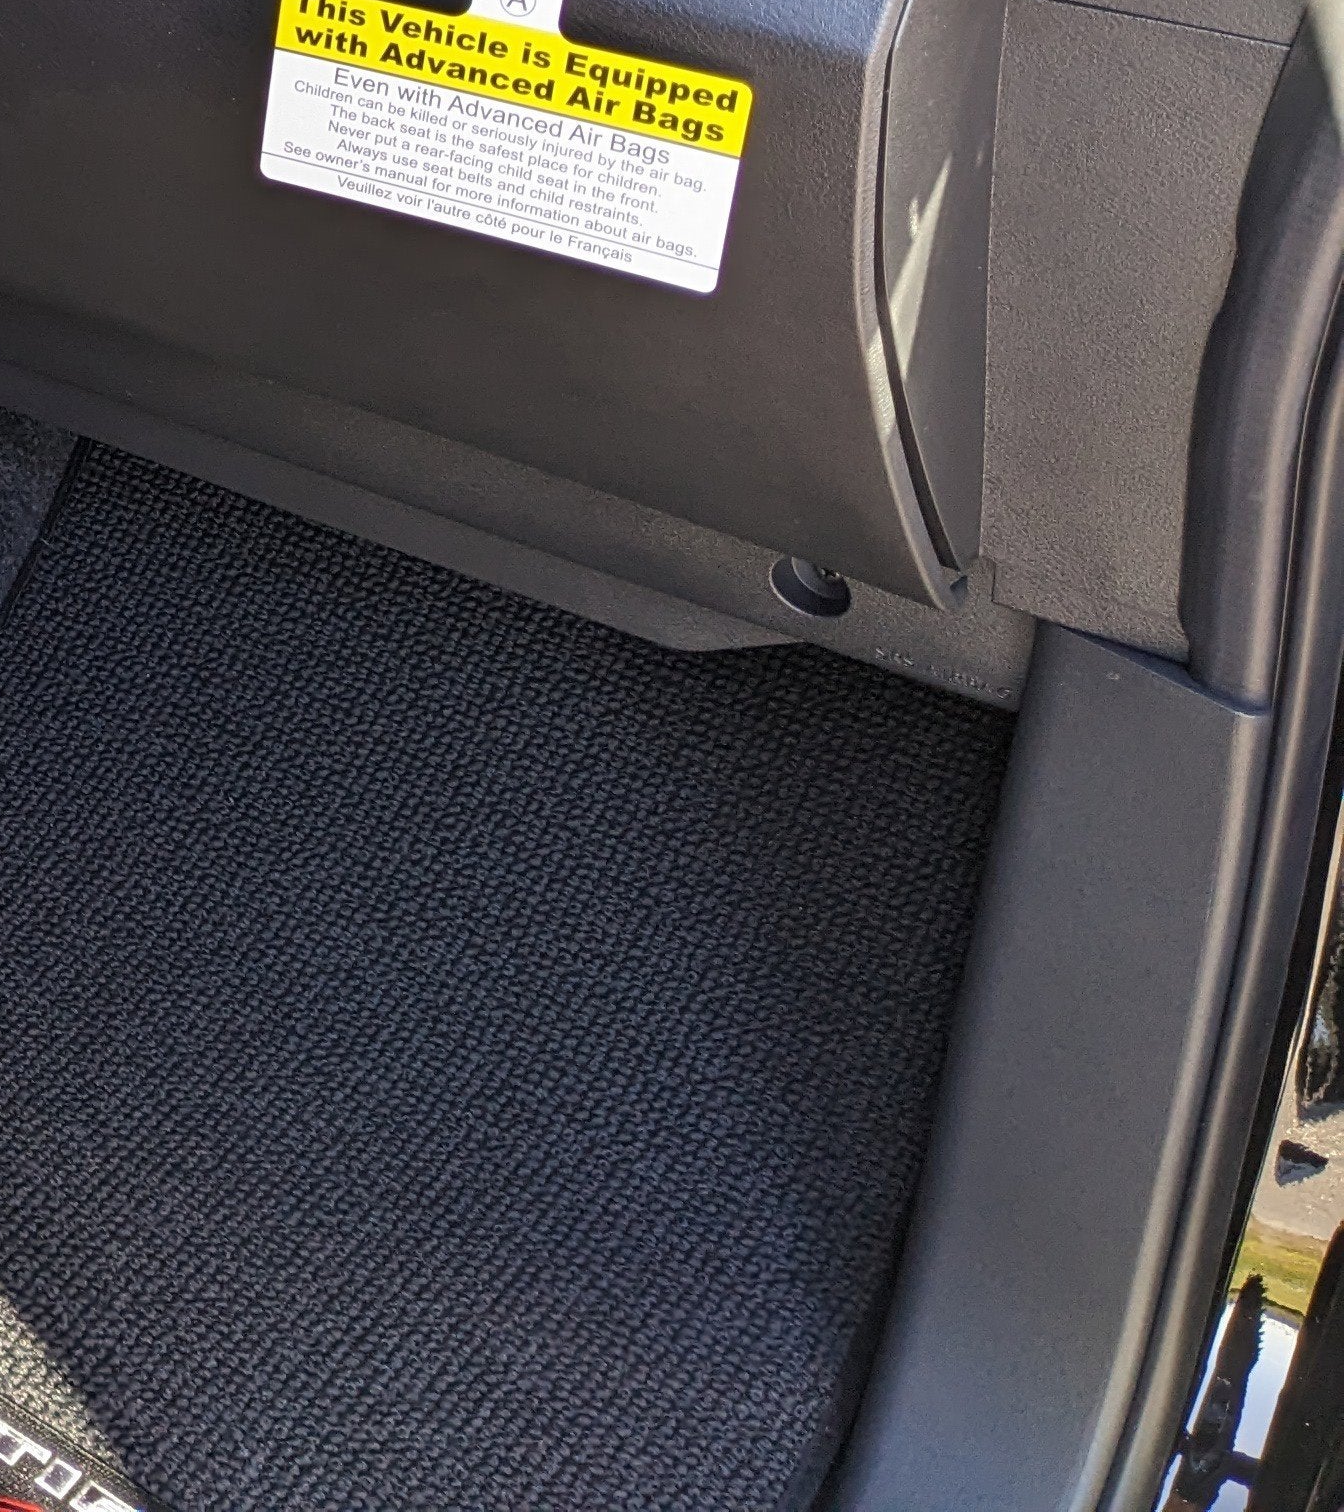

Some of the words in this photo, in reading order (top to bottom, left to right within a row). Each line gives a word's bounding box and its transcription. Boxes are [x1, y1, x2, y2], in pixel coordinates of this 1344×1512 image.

[295, 26, 367, 57] with
[379, 42, 554, 100] Advanced
[566, 85, 618, 115] Air
[632, 99, 723, 141] Bags
[380, 9, 508, 58] Vehicle
[521, 42, 550, 68] is
[564, 51, 738, 112] Equipped
[293, 79, 353, 104] Children
[356, 96, 383, 111] can
[387, 101, 406, 117] be
[409, 106, 448, 127] killed
[451, 119, 468, 131] or
[470, 124, 538, 151] seriously
[541, 138, 593, 162] injured
[597, 152, 616, 170] by
[620, 158, 644, 175] the
[648, 167, 669, 181] air
[673, 171, 706, 193] bag.
[329, 103, 357, 121] The
[360, 111, 395, 131] back
[399, 123, 431, 139] seat
[434, 129, 446, 143] is
[451, 133, 474, 150] the
[478, 142, 523, 162] safest
[527, 154, 568, 173] place
[572, 163, 593, 179] for
[596, 171, 662, 198] children.
[333, 66, 389, 96] Even
[397, 85, 441, 108] with
[447, 94, 563, 138] Advanced
[568, 123, 603, 146] Air
[609, 133, 669, 165] Bags
[283, 140, 311, 158] See
[314, 150, 370, 173] owner's
[374, 165, 428, 187] manual
[431, 177, 452, 193] for
[455, 185, 492, 203] more
[496, 193, 579, 226] information
[583, 218, 627, 239] about
[631, 231, 652, 244] air
[655, 235, 696, 257] bags.
[327, 118, 371, 140] Never
[373, 133, 397, 147] put
[400, 140, 410, 151] a
[414, 143, 493, 174] rear-facing
[497, 163, 533, 181] child
[536, 173, 568, 190] seat
[572, 180, 586, 195] in
[591, 185, 615, 202] the
[619, 192, 657, 213] front.
[336, 138, 387, 161] Always
[391, 153, 418, 168] use
[421, 161, 453, 178] seat
[457, 167, 492, 187] belts
[496, 180, 525, 195] and
[529, 187, 564, 205] child
[568, 198, 642, 226] restraints.
[337, 174, 392, 200] Veuillez
[396, 192, 423, 207] voir
[426, 197, 471, 220] l'autre
[474, 212, 507, 229] côté
[510, 222, 545, 239] pour
[548, 229, 563, 244] le
[567, 234, 632, 262] Français
